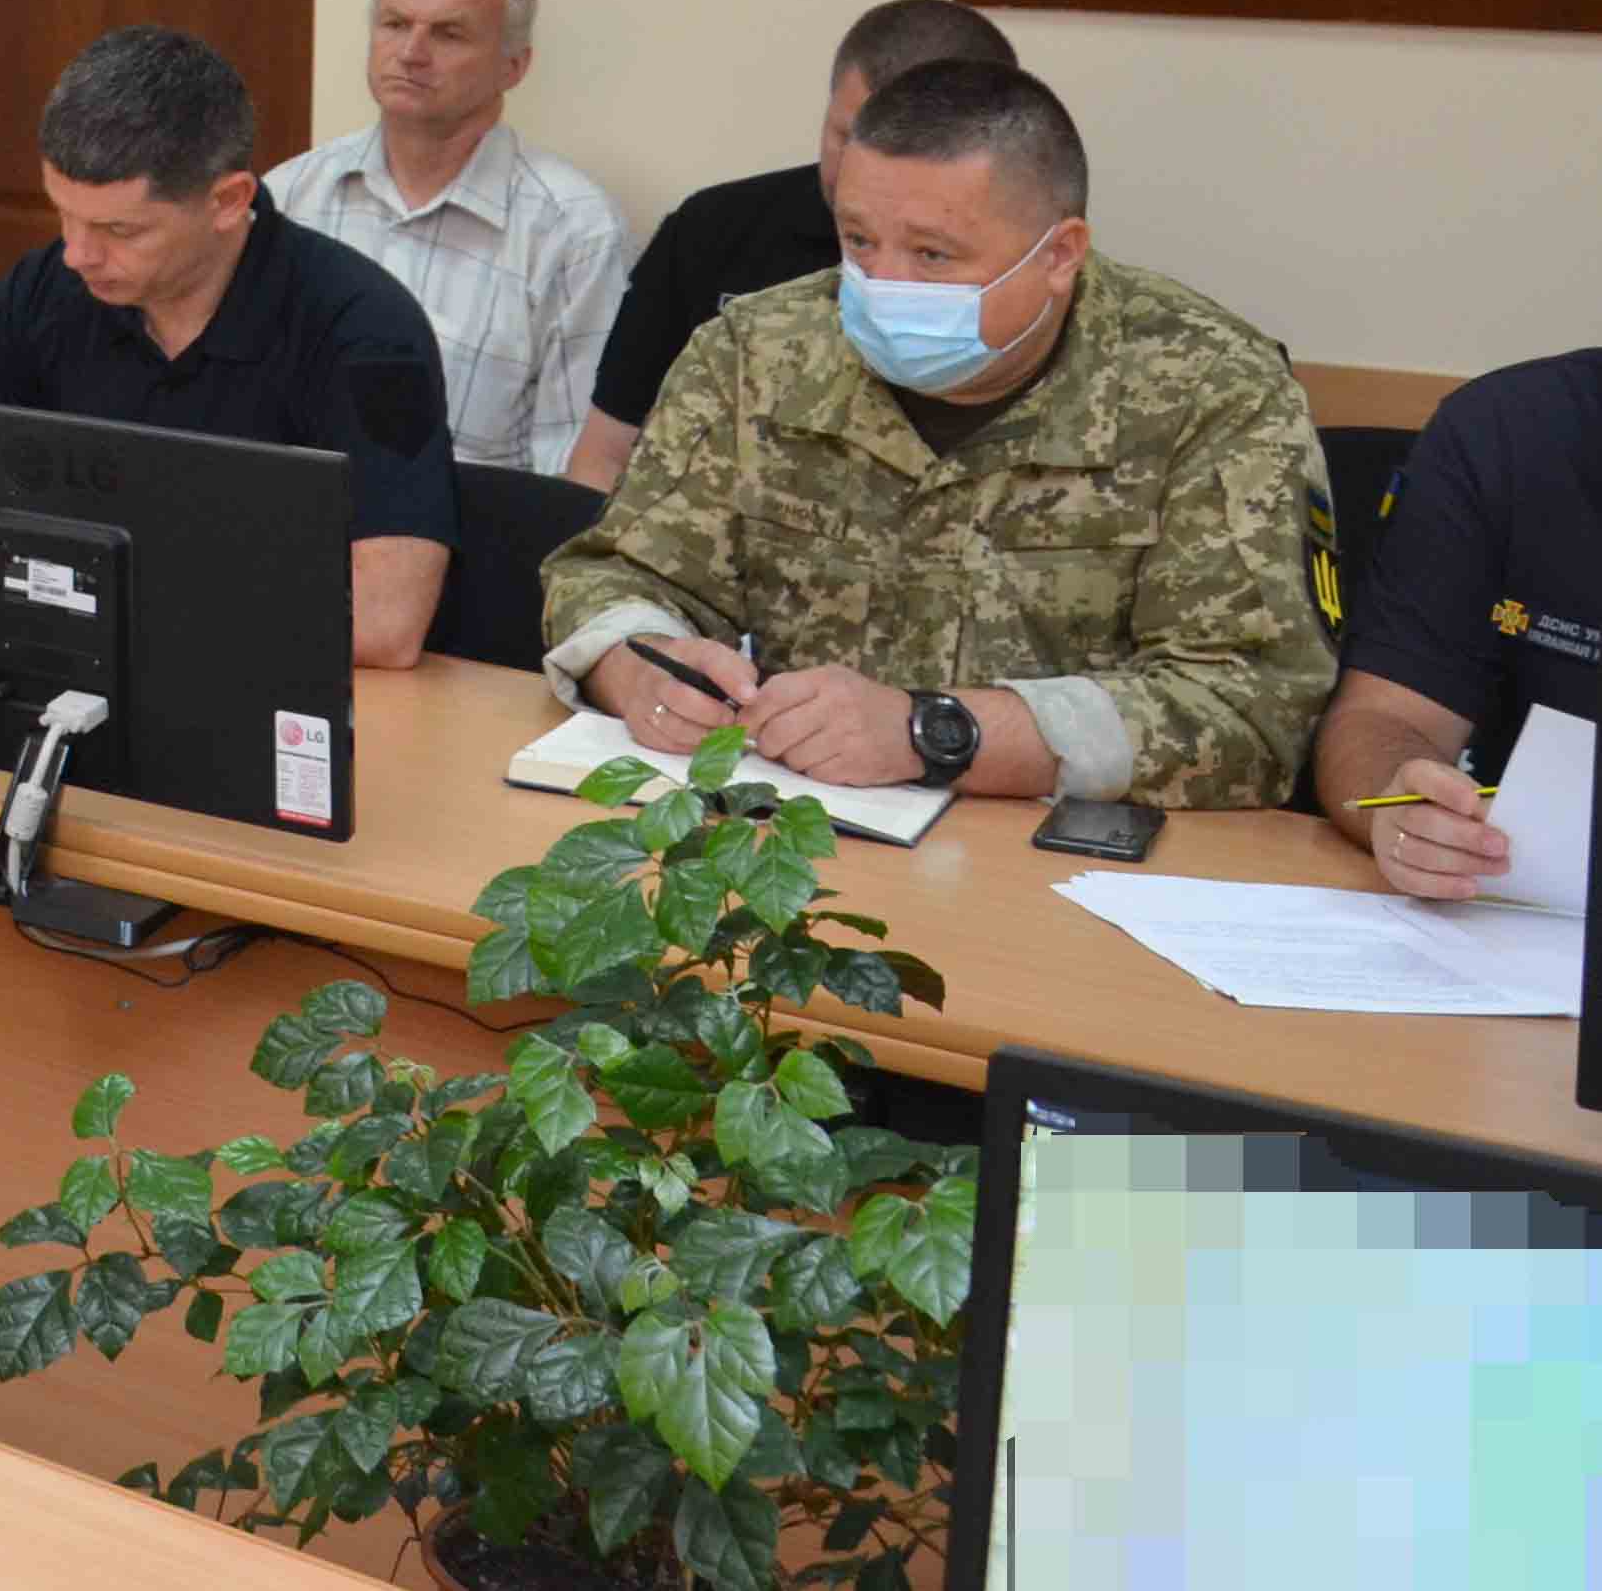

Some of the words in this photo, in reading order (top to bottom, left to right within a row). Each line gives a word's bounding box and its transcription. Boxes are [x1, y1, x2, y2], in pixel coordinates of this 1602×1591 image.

[63, 450, 119, 495] LG
[1537, 613, 1581, 637] ДСНС
[306, 728, 326, 744] LG
